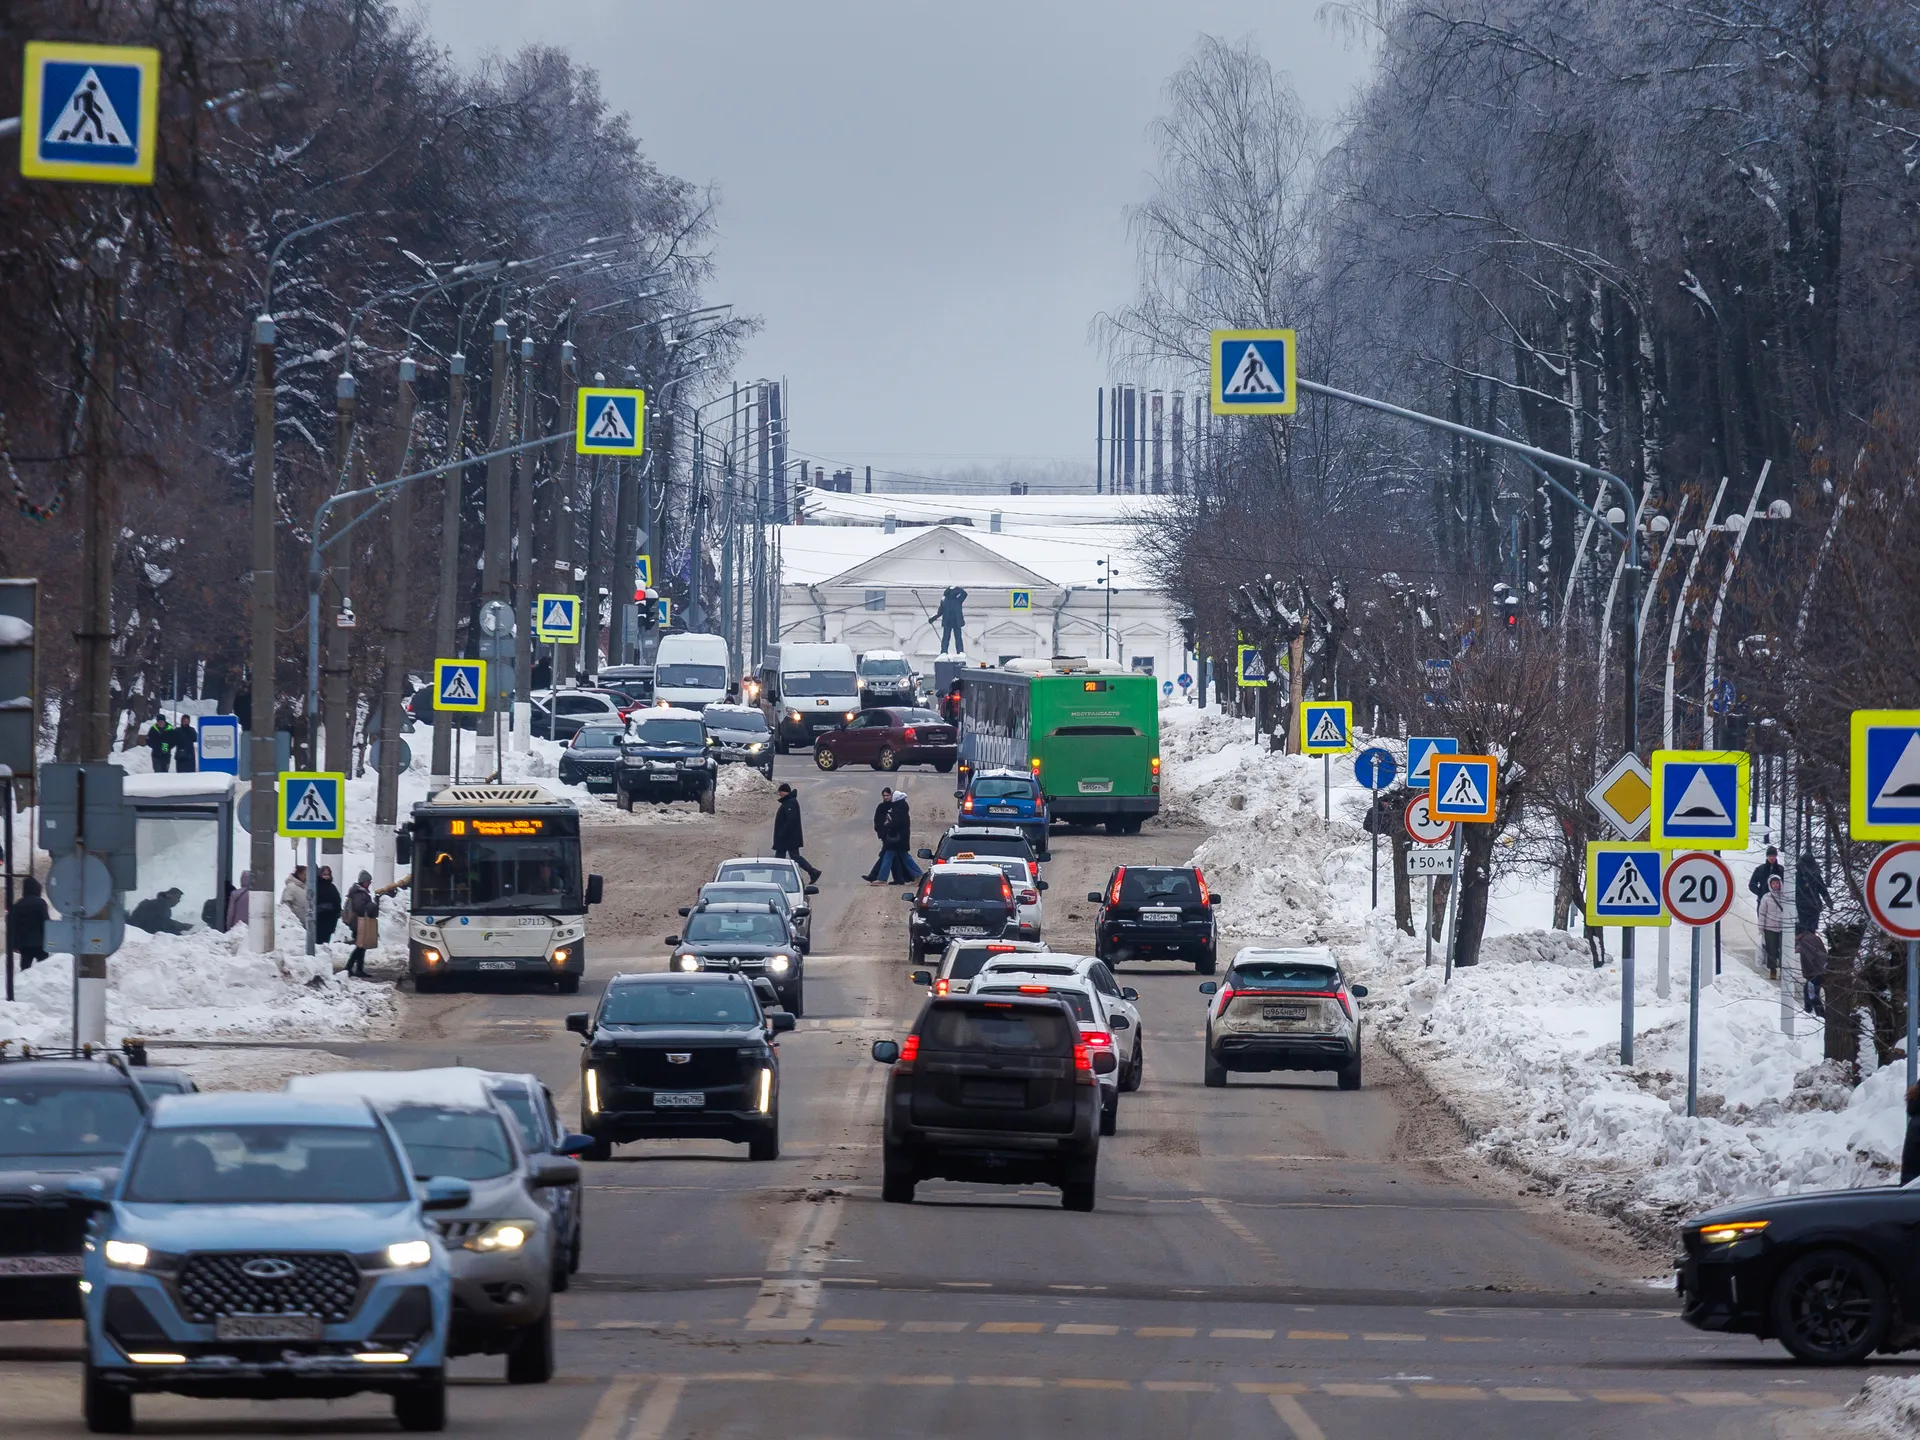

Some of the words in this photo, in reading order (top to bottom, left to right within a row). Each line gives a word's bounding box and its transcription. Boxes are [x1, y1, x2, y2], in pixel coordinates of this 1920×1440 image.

[451, 820, 465, 835] 10
[1420, 857, 1435, 868] 50
[1678, 874, 1718, 903] 20
[1888, 871, 1920, 909] 2
